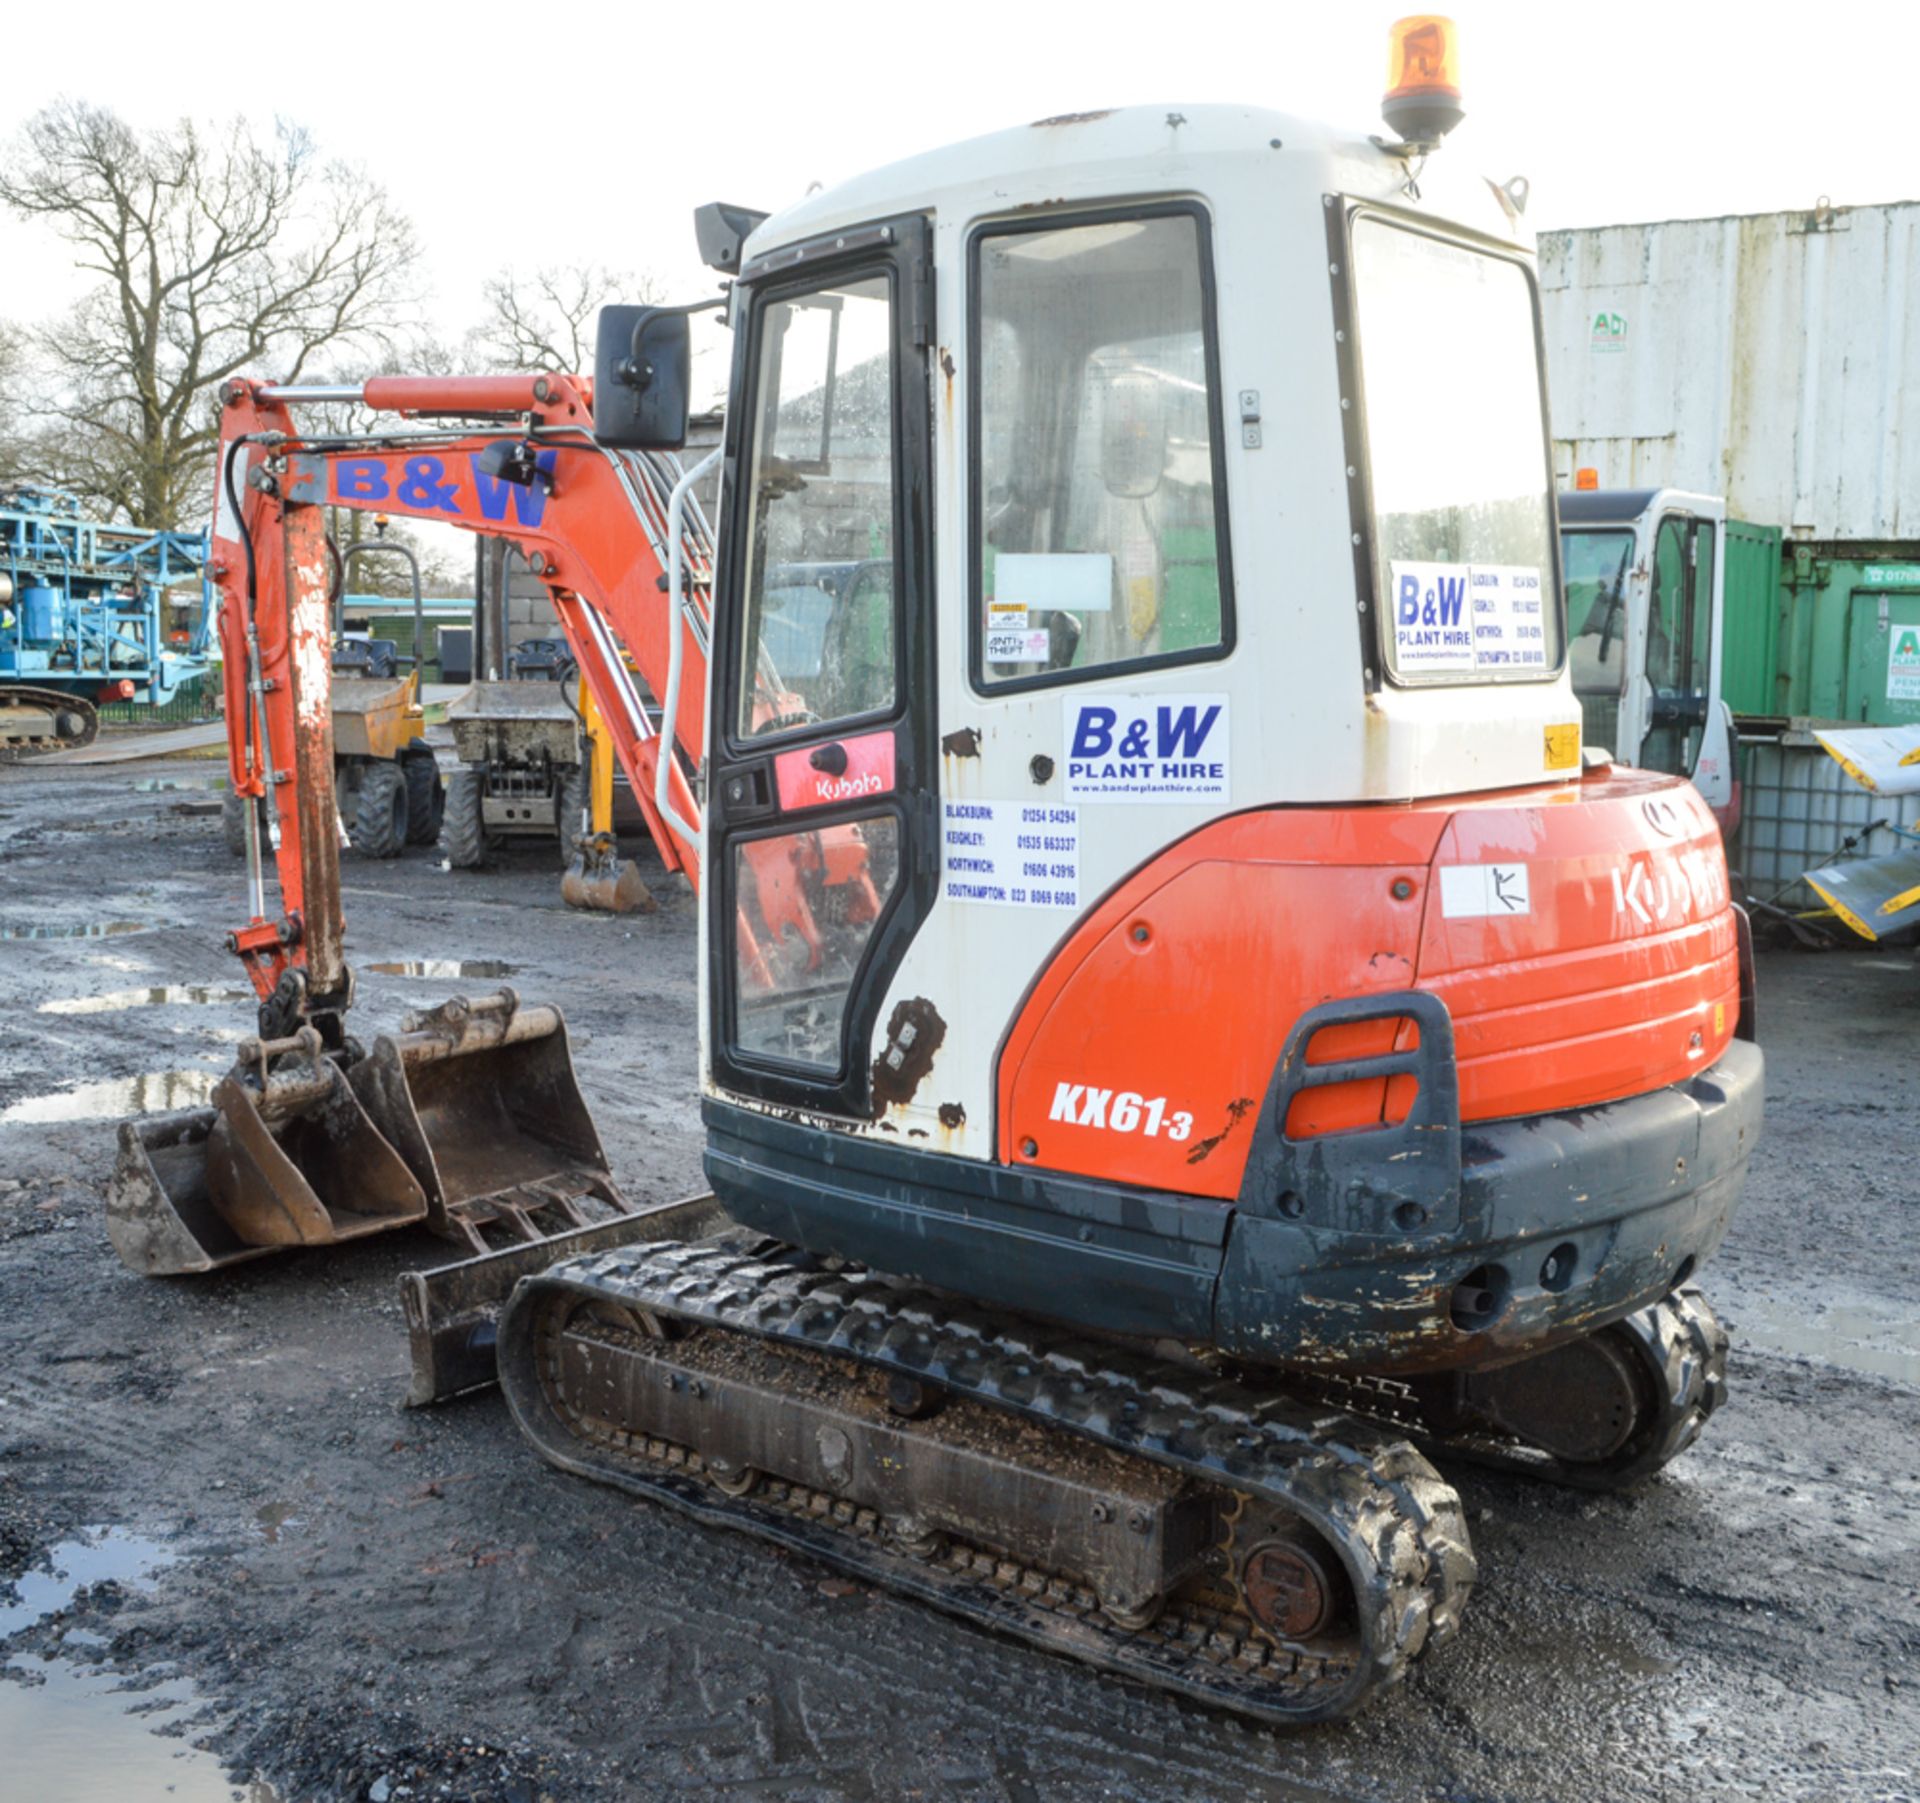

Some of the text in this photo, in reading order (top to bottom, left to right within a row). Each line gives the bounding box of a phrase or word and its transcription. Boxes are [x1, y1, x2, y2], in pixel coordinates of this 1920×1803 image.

[336, 449, 558, 529] B&W
[1398, 575, 1466, 627] B&W
[1399, 631, 1471, 646] PLANT HIRE
[989, 646, 1024, 656] THEFT
[1070, 705, 1222, 759] B&W
[1069, 763, 1224, 779] PLANT HIRE
[816, 771, 882, 800] Kubota
[1072, 783, 1222, 794] www.bandwplanthire.com
[946, 804, 993, 820] BLACKBURN:
[946, 830, 985, 846] KEIGHLEY:
[1017, 835, 1042, 849] 01535
[947, 857, 994, 873] NORTHWICH:
[947, 882, 1006, 901] SOUTHAMPTON:
[1011, 888, 1026, 902] 023
[1049, 1082, 1194, 1141] KX61-3
